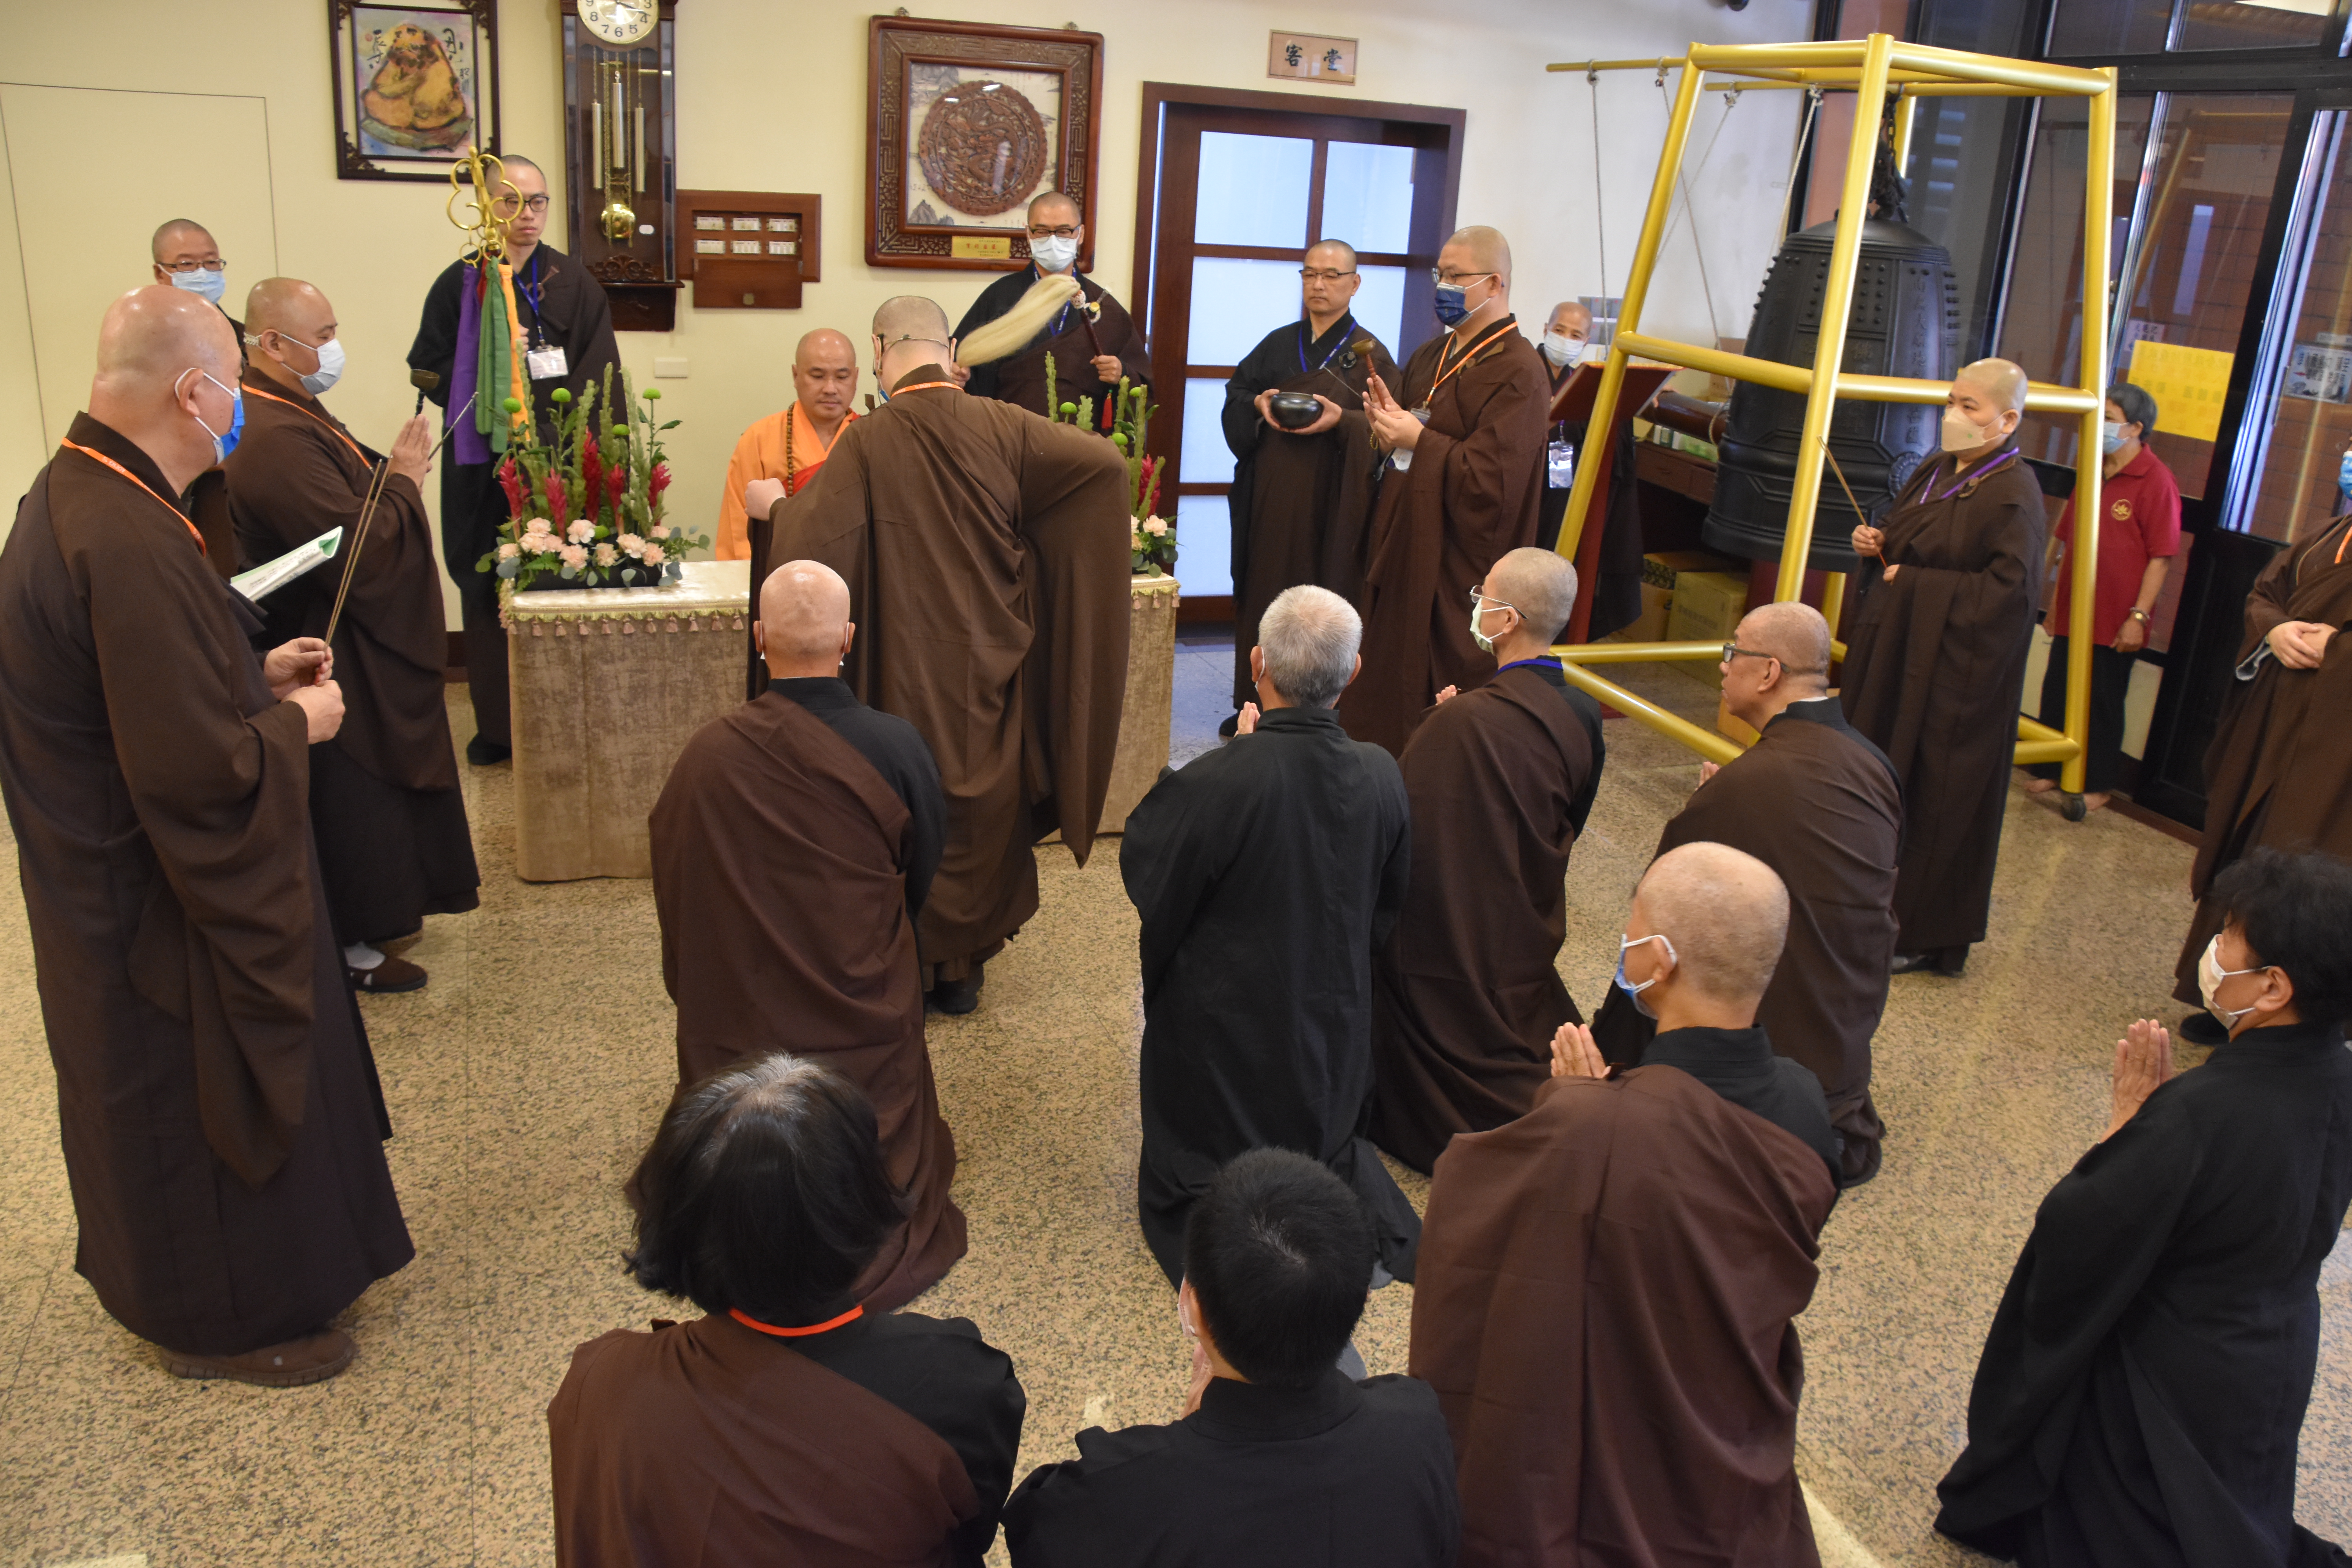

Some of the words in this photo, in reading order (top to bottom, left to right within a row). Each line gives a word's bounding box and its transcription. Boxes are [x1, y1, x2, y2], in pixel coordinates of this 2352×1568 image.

[644, 0, 652, 8] 3
[590, 11, 598, 21] 8
[640, 13, 648, 23] 4
[601, 24, 609, 33] 7
[614, 27, 623, 37] 6
[629, 24, 638, 34] 5
[1285, 44, 1342, 71] 客堂
